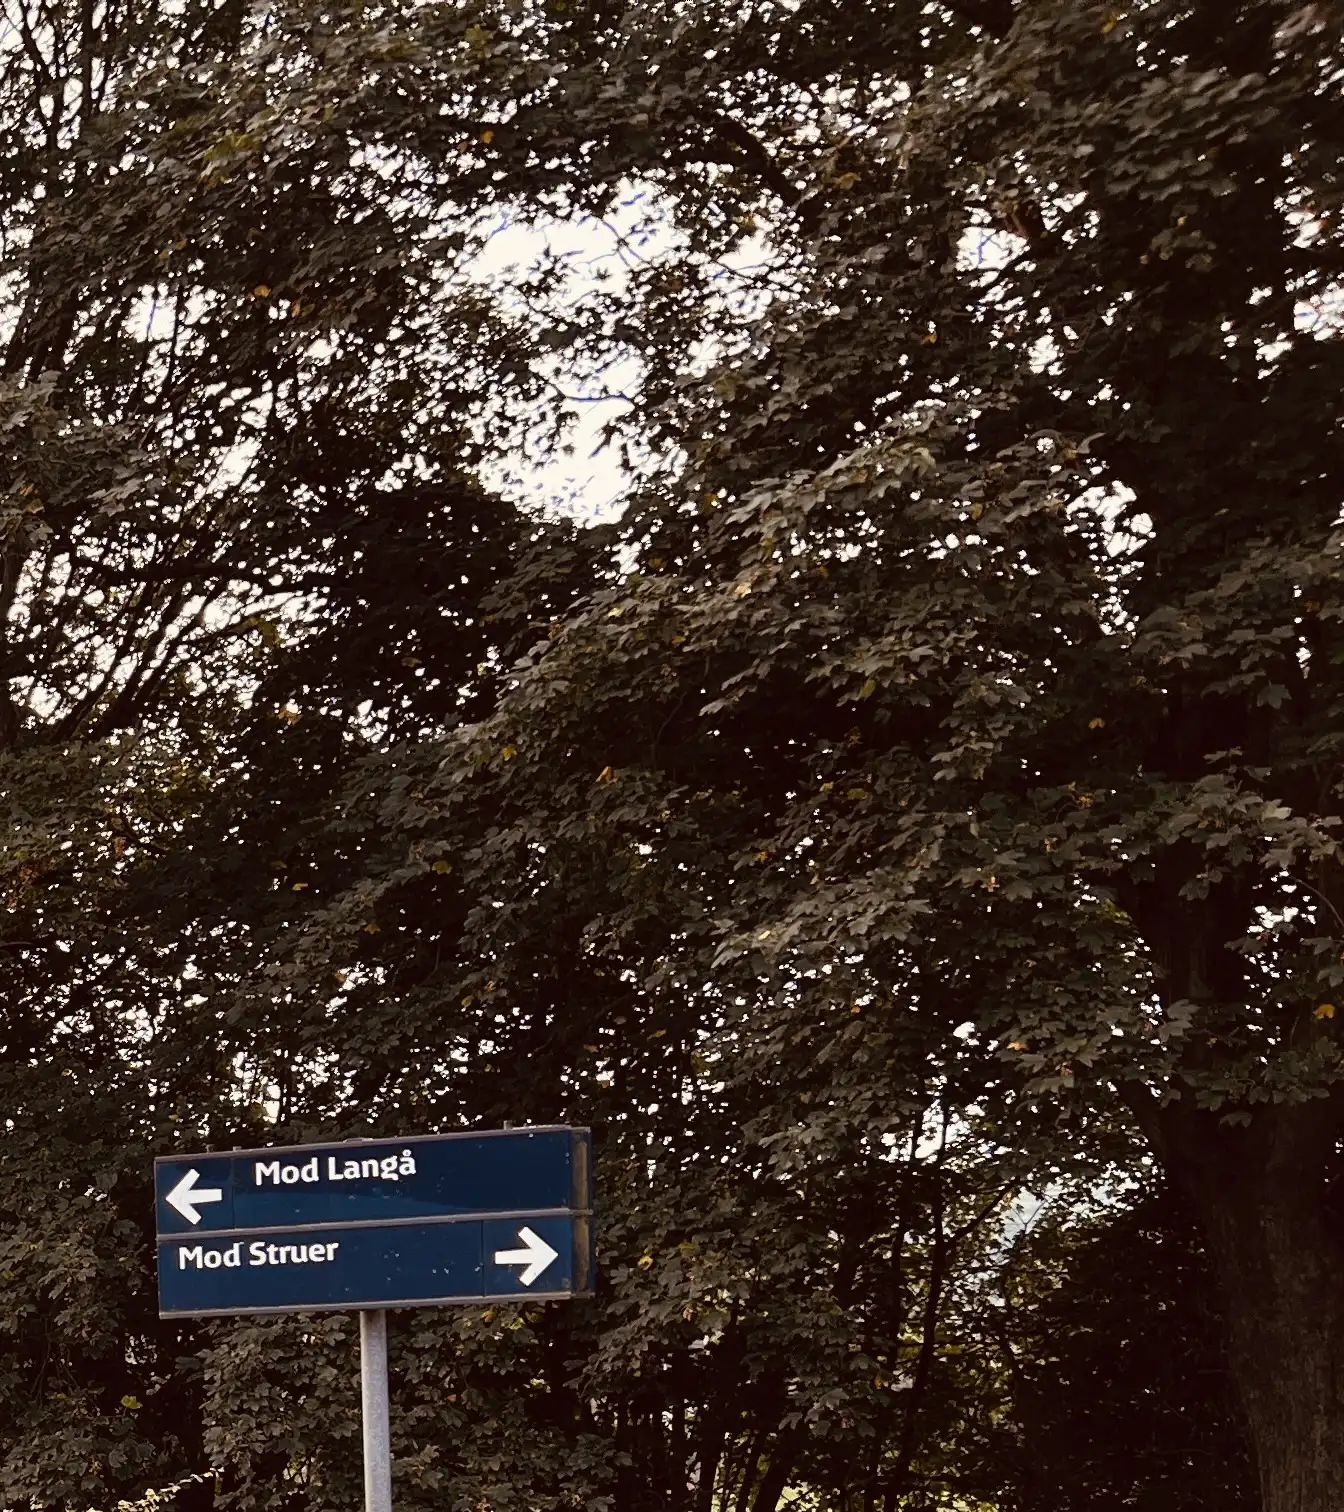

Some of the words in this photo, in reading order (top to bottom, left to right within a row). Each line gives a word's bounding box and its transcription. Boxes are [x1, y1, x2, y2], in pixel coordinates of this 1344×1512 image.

[255, 1157, 319, 1186] Mod
[328, 1149, 417, 1181] Langå
[179, 1242, 242, 1270] Mod
[249, 1241, 340, 1266] Struer
